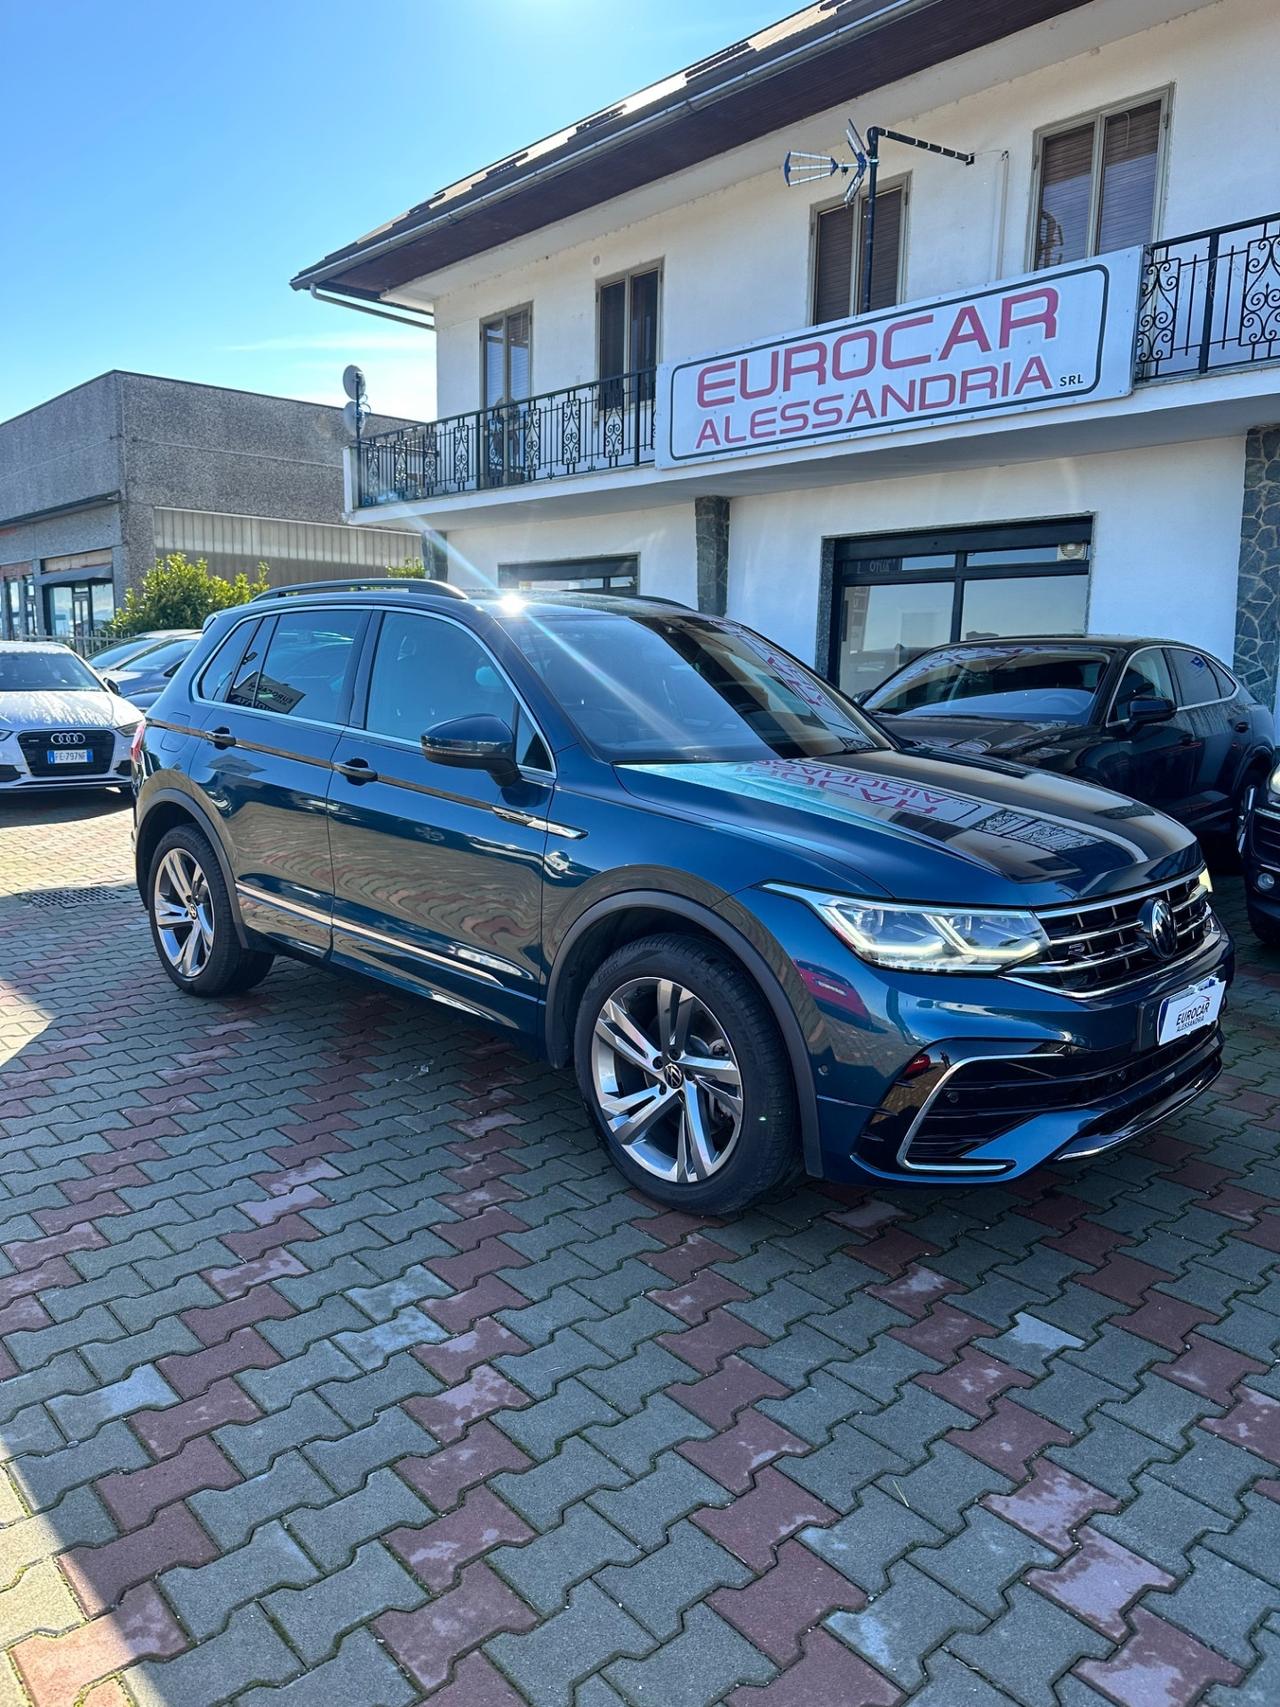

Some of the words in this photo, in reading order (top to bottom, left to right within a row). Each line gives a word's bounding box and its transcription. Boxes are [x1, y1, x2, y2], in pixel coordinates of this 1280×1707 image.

[697, 287, 1058, 409] EUROCAR
[696, 357, 1052, 448] ALESSANDRIA
[1059, 373, 1084, 387] SRL
[1176, 1002, 1210, 1026] EUROCAR
